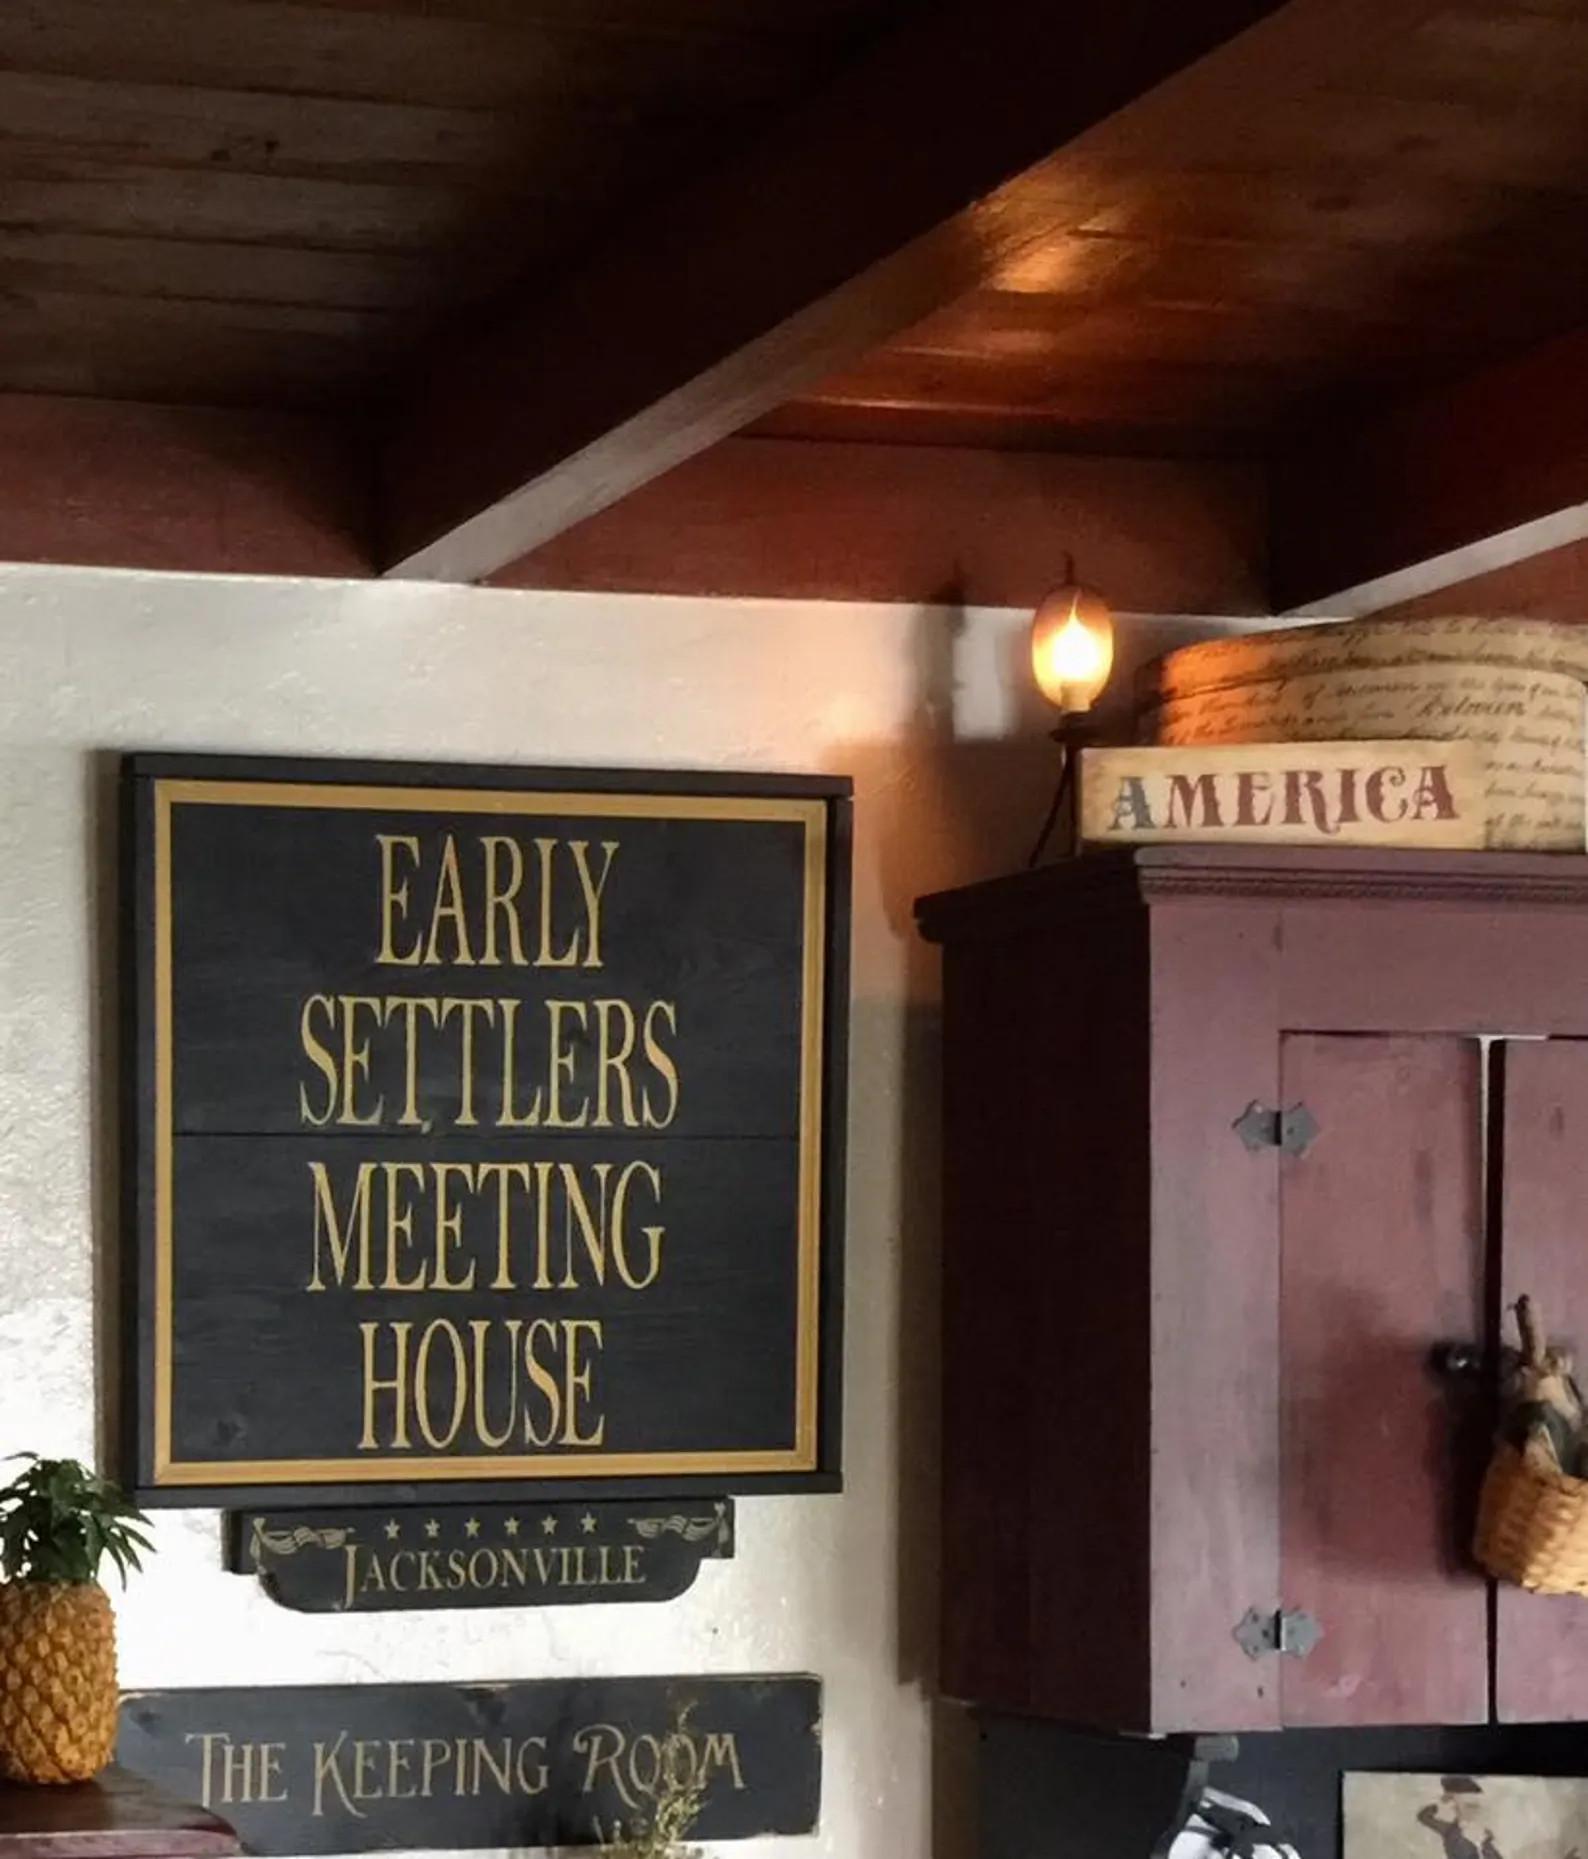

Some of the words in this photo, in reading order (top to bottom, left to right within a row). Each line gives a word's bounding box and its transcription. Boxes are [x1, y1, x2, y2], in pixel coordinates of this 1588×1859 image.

[1107, 764, 1461, 835] AMERICA
[374, 834, 620, 968] EARLY
[299, 994, 679, 1131] SETTLERS
[306, 1161, 665, 1293] MEETING
[357, 1318, 606, 1451] HOUSE
[341, 1545, 647, 1610] JACKSONVILLE
[184, 1732, 288, 1809] THE
[311, 1729, 550, 1819] KEEPING
[573, 1724, 745, 1810] ROOM
